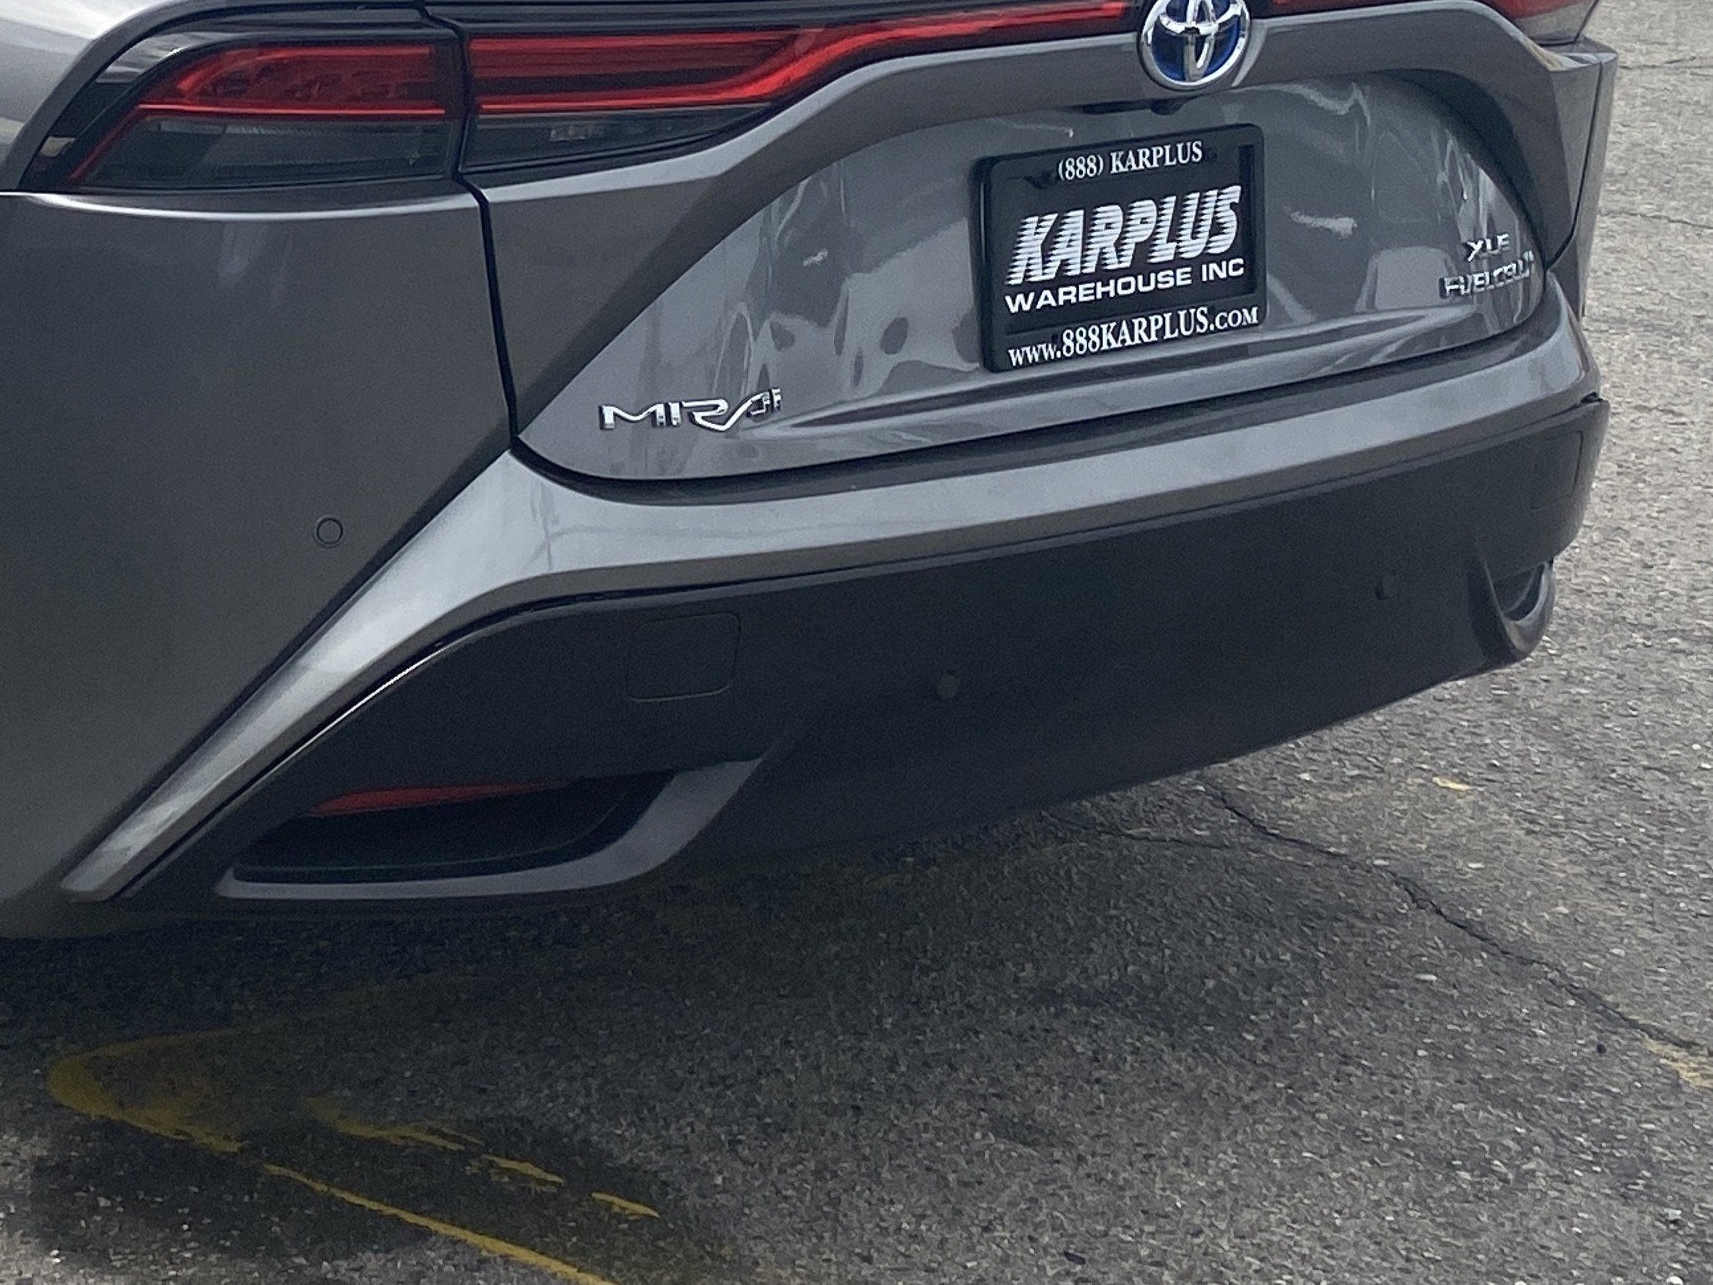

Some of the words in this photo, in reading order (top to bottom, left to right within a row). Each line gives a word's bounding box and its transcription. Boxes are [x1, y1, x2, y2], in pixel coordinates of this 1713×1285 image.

[1057, 155, 1104, 181] (888)
[1110, 141, 1203, 174] KARPLUS
[1004, 185, 1242, 285] KARPLUS
[1466, 233, 1510, 262] XLE
[1005, 267, 1192, 313] WAREHOUSE
[1201, 258, 1244, 282] INC
